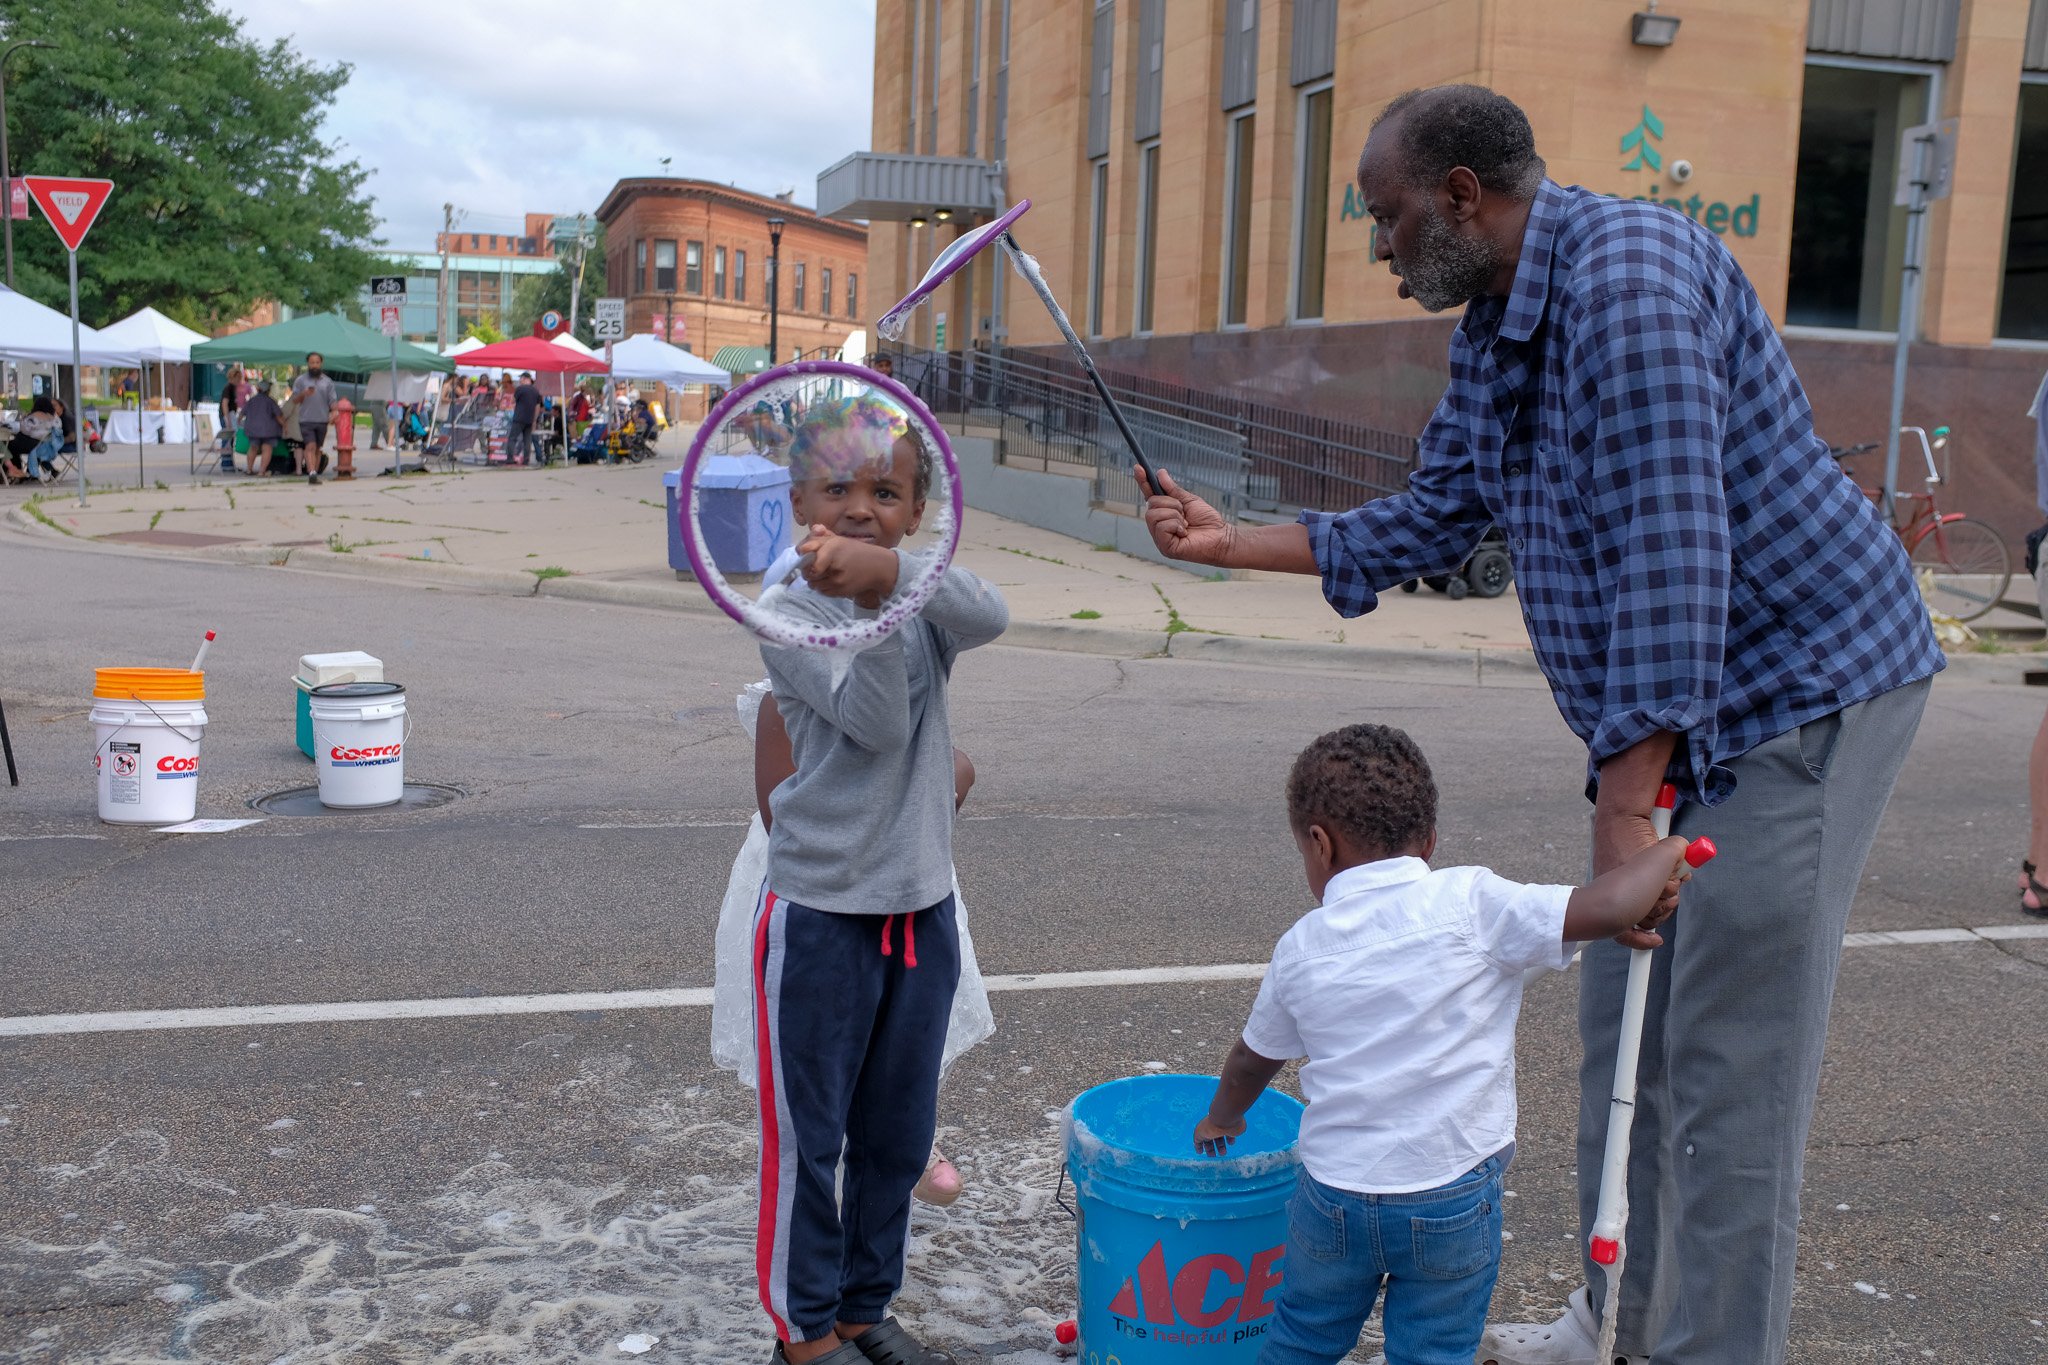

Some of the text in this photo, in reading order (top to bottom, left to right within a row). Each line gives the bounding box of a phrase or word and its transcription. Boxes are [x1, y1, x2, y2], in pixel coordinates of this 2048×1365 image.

[57, 196, 83, 207] YIELD
[598, 302, 623, 310] SPEED
[600, 311, 620, 319] LIMIT
[598, 320, 622, 335] 25
[330, 743, 401, 761] COSTCO
[1107, 1238, 1287, 1329] ACE
[1112, 1316, 1148, 1339] The
[1153, 1327, 1227, 1348] helpful
